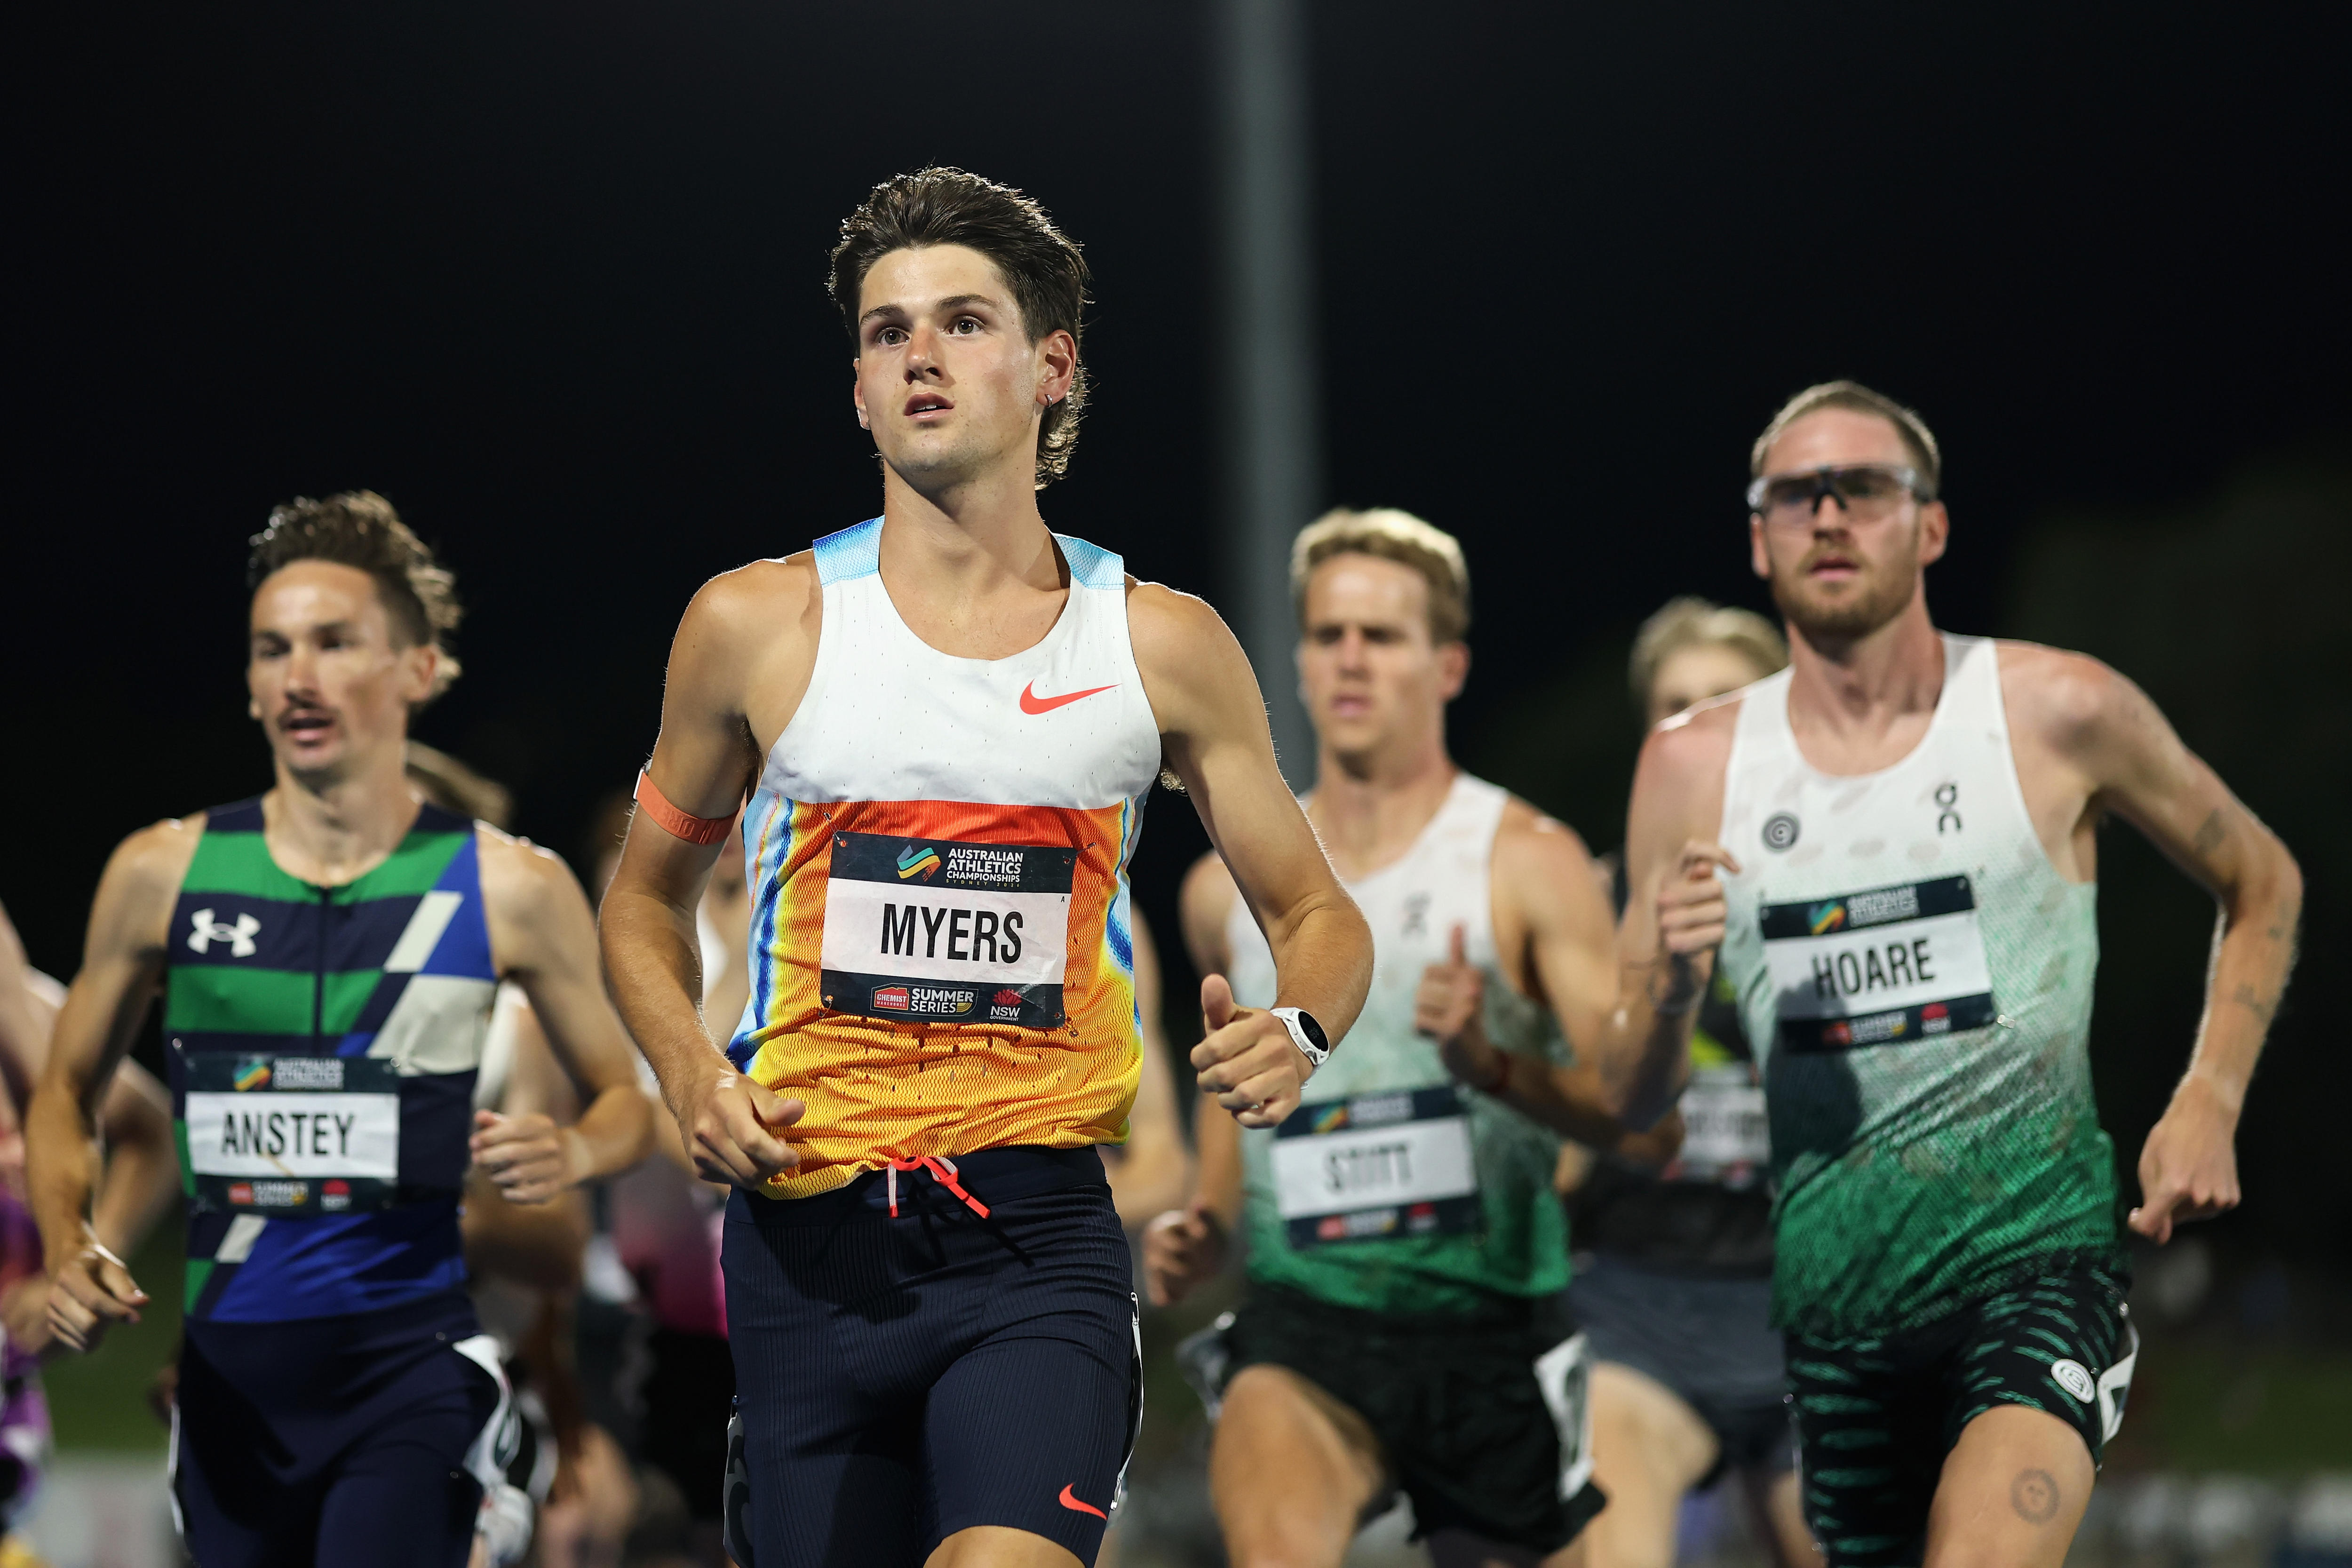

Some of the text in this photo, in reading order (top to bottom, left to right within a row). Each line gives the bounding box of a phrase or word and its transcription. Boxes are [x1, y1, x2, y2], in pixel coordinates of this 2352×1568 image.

[948, 848, 1024, 862] AUSTRALIAN
[947, 859, 1022, 874] ATHLETICS
[946, 871, 1020, 883] CHAMPIONSHIPS
[881, 903, 1024, 964] MYERS
[1812, 938, 1935, 1000] HOARE
[877, 994, 907, 1003] CHEMIST
[912, 988, 974, 1003] SUMMER
[911, 1000, 956, 1013] SERIES
[990, 1005, 1020, 1018] NSW
[221, 1111, 355, 1157] ANSTEY
